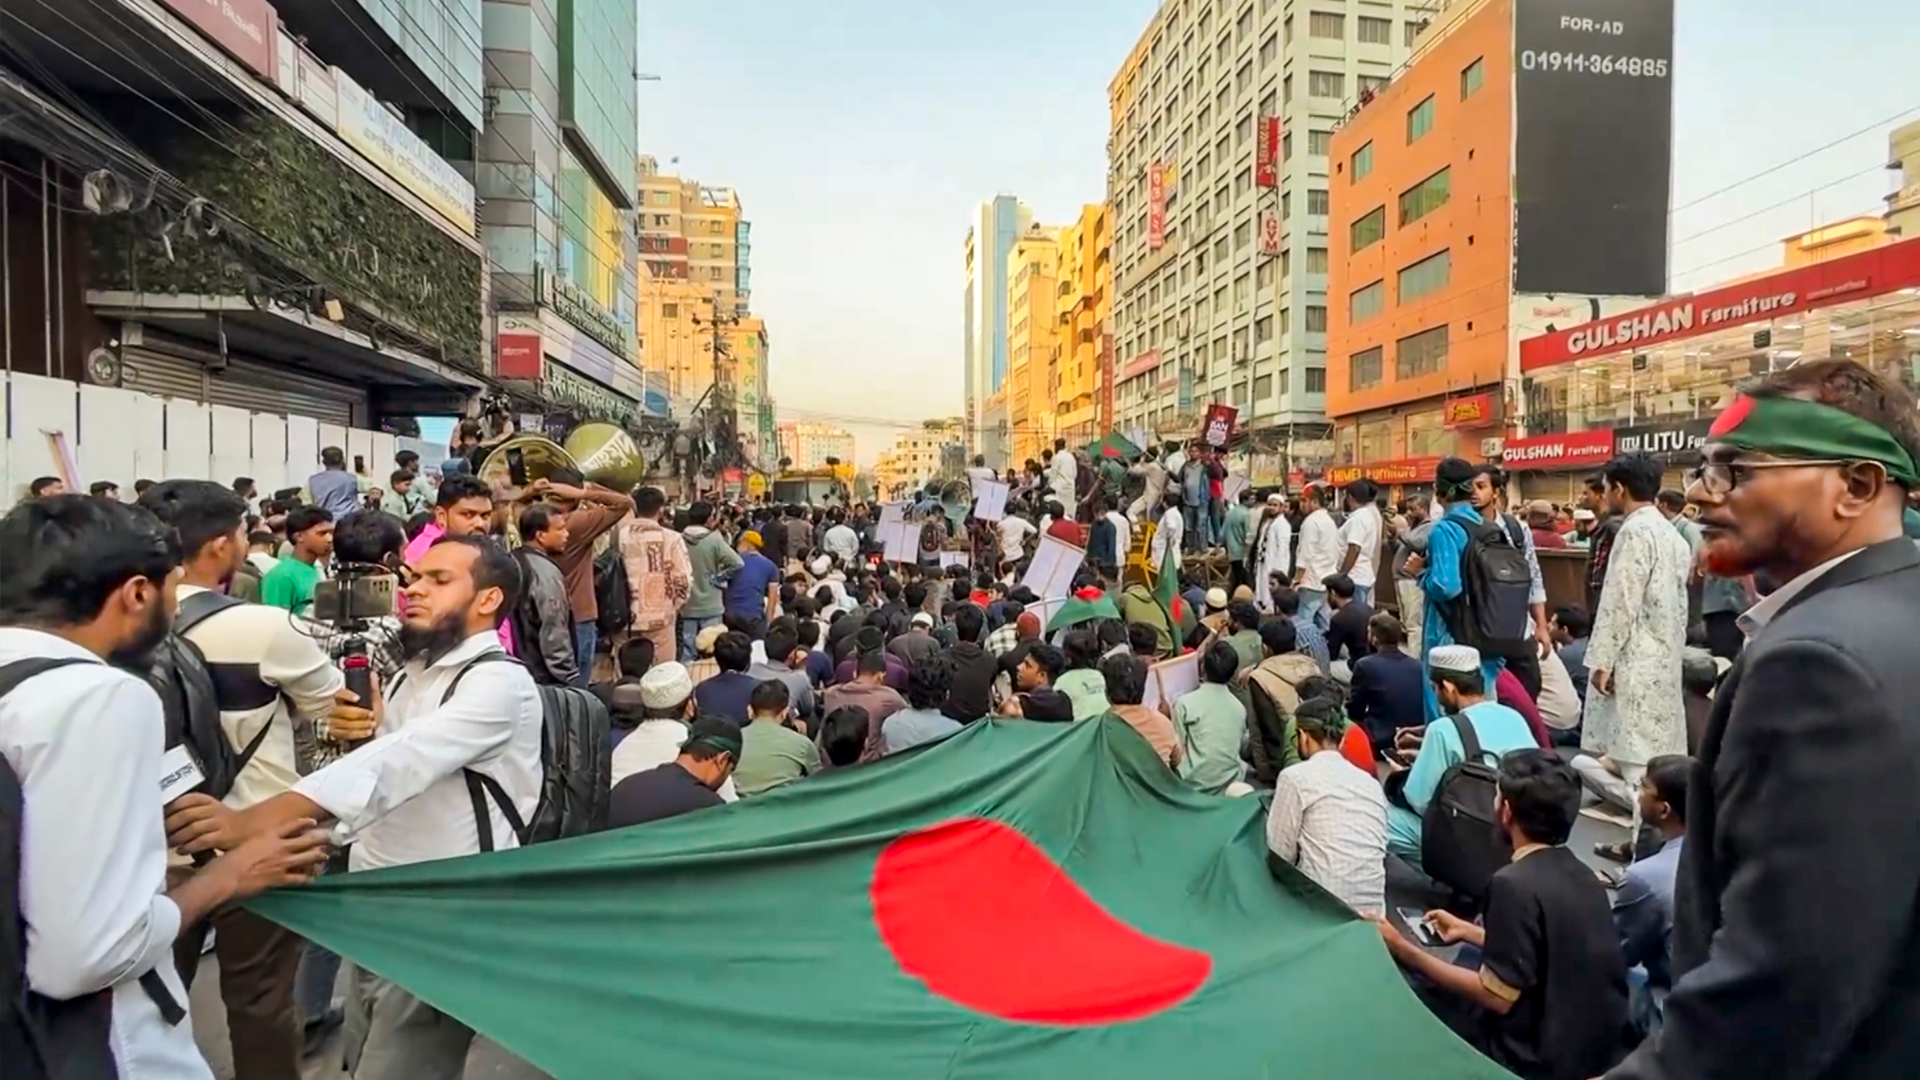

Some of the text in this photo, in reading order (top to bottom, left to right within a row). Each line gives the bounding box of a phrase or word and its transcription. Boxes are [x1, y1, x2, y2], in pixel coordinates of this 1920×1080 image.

[1560, 15, 1624, 36] FOR-AD
[1521, 50, 1668, 78] 01911-364885
[1265, 218, 1279, 252] GYM
[1567, 303, 1696, 354] GULSHAN
[1701, 289, 1797, 325] Furniture
[1643, 430, 1685, 452] LITU
[1502, 443, 1610, 462] GULSHAN Furniture
[1366, 463, 1417, 481] Furniture
